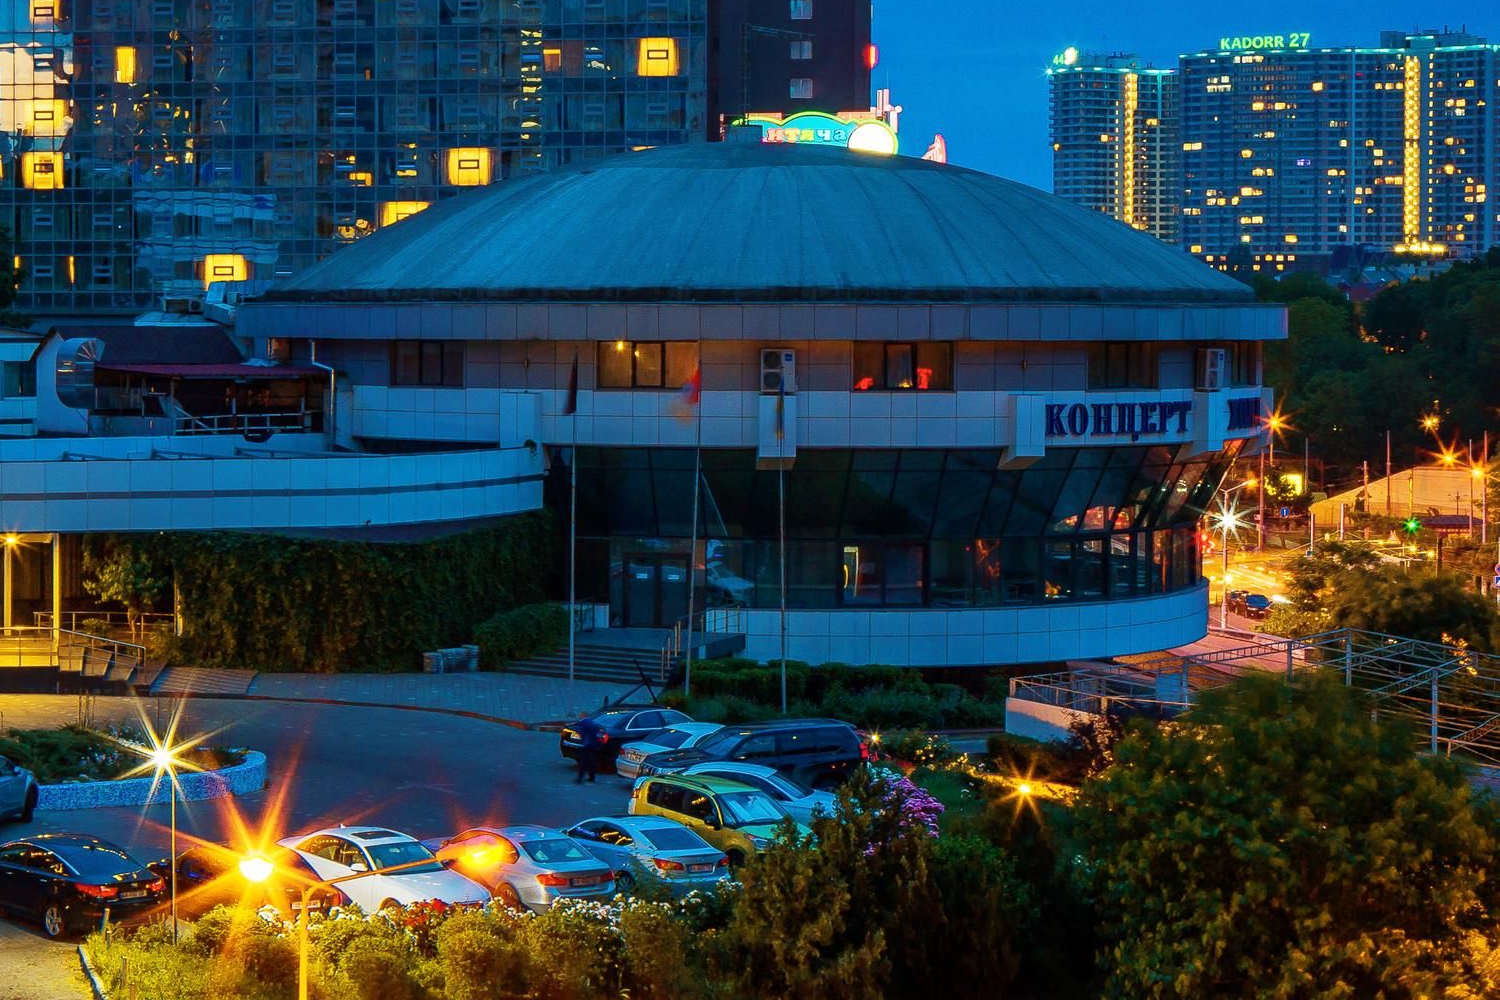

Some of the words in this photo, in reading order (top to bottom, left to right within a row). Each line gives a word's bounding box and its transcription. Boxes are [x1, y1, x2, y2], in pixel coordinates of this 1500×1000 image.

[1220, 35, 1284, 50] KADORR
[1289, 33, 1311, 48] 27
[764, 127, 847, 143] итяча
[1045, 400, 1192, 442] КОНЦЕРТ
